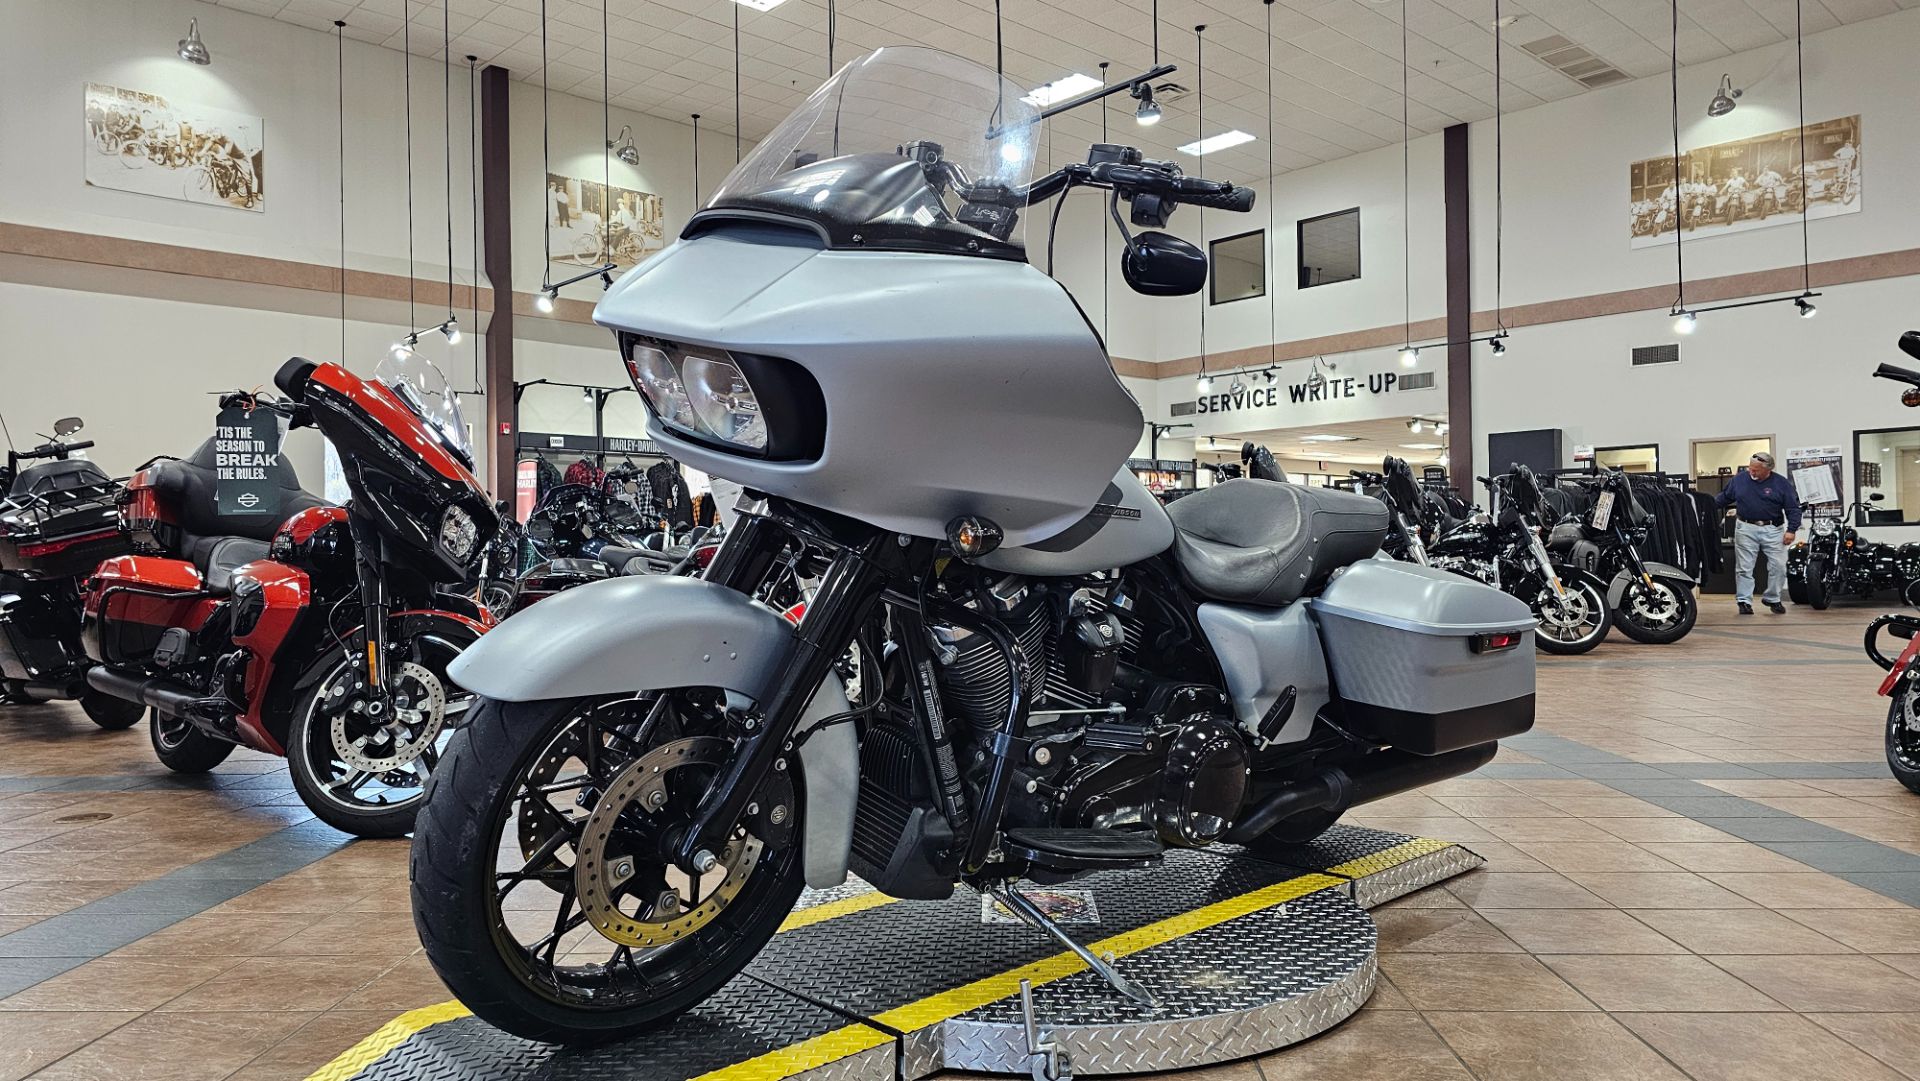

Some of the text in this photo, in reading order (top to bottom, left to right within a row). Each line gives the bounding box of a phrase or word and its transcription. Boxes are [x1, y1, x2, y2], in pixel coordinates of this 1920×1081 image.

[1197, 372, 1397, 414] SERVICE WRITE-UP
[216, 426, 252, 439] 'TIS THE
[215, 440, 265, 453] SEASON TO
[610, 438, 664, 453] HARLEY-DAVID
[216, 453, 278, 467] BREAK
[217, 467, 267, 480] THE RULES.
